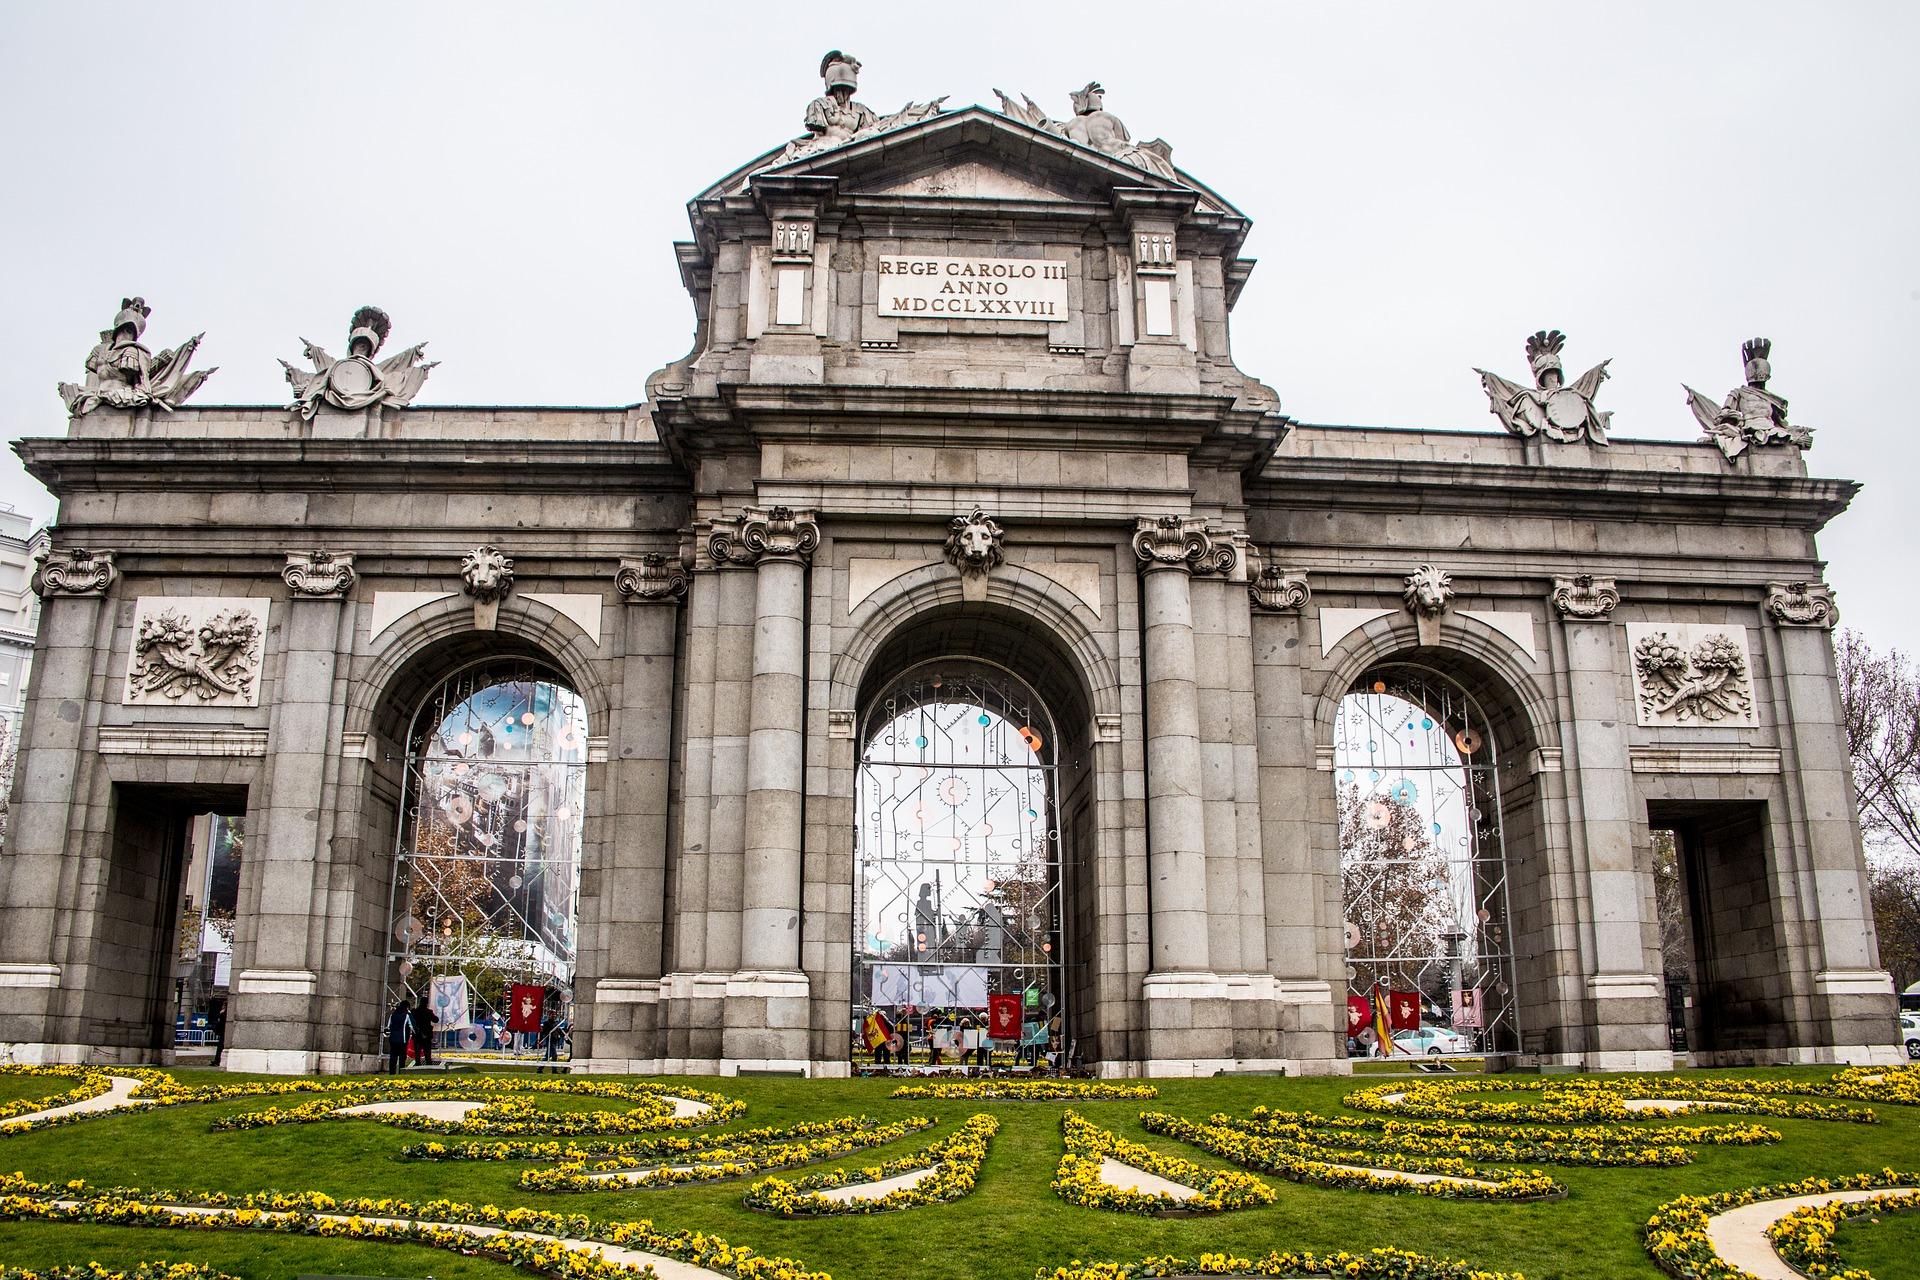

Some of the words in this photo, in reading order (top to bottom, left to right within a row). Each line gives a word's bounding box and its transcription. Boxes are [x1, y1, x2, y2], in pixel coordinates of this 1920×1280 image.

[880, 261, 938, 275] REGE
[946, 263, 1036, 278] CAROLO
[1043, 266, 1067, 279] III
[940, 281, 1008, 295] ANNO
[892, 297, 1055, 315] MDCCLXXVIII
